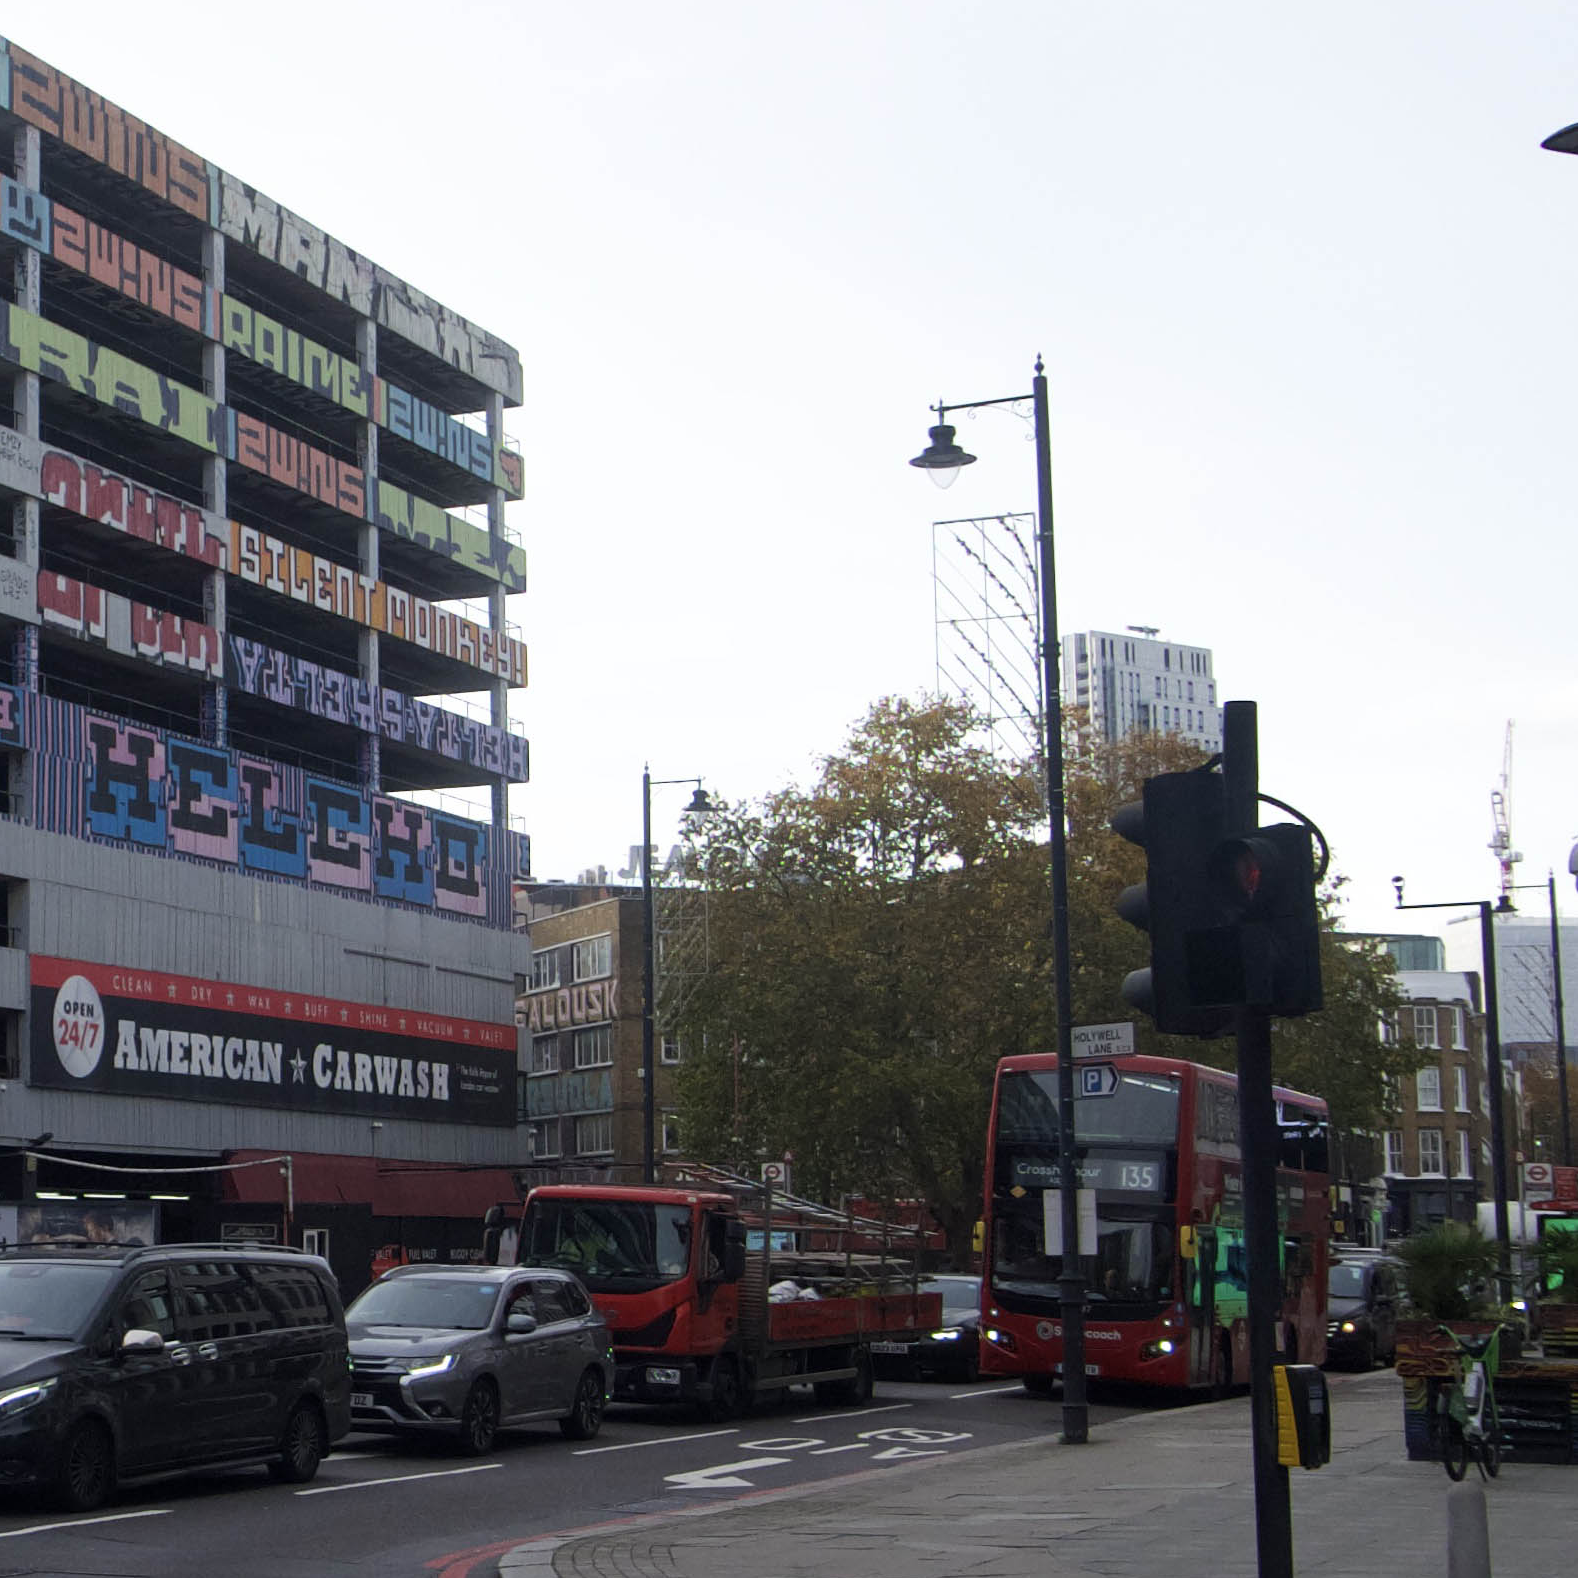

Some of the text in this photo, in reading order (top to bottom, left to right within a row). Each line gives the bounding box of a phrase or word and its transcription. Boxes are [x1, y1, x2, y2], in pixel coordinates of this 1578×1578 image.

[112, 974, 153, 995] CLEAN
[190, 985, 213, 1002] DRY
[247, 995, 272, 1011] WAX
[304, 1002, 330, 1019] BUFF
[63, 1000, 95, 1018] OPEN
[57, 1018, 100, 1050] 24/7
[1074, 1028, 1122, 1044] HOLYWELL
[1088, 1042, 1113, 1055] LANE
[113, 1019, 283, 1086] AMERICAN
[312, 1042, 451, 1102] CARWASH
[1086, 1071, 1100, 1091] P
[1120, 1165, 1154, 1189] 135
[1053, 1325, 1122, 1342] Scoach
